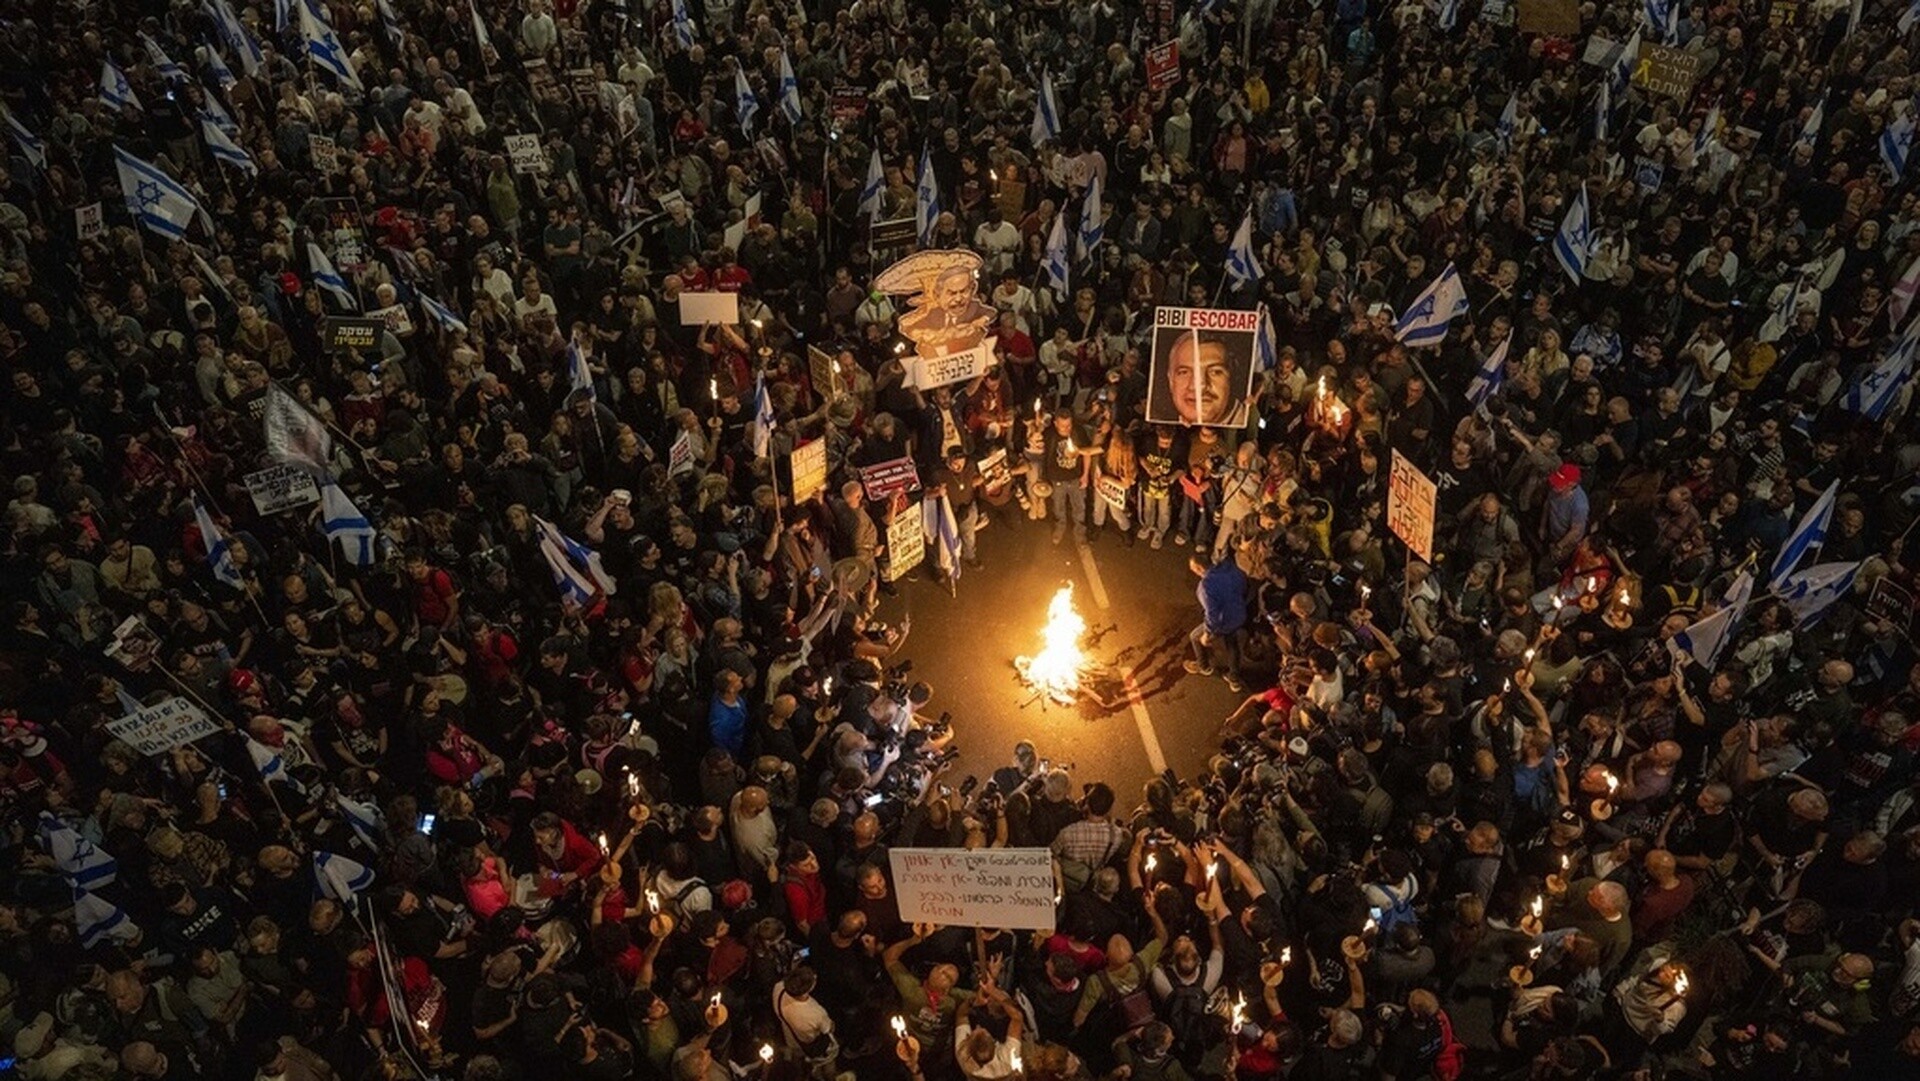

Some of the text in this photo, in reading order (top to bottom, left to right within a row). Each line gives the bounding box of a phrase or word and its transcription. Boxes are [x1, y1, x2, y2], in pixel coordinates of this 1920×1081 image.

[1157, 309, 1258, 330] BIBI ESCOBAR
[338, 326, 373, 336] עסקה
[928, 353, 975, 375] מורשת
